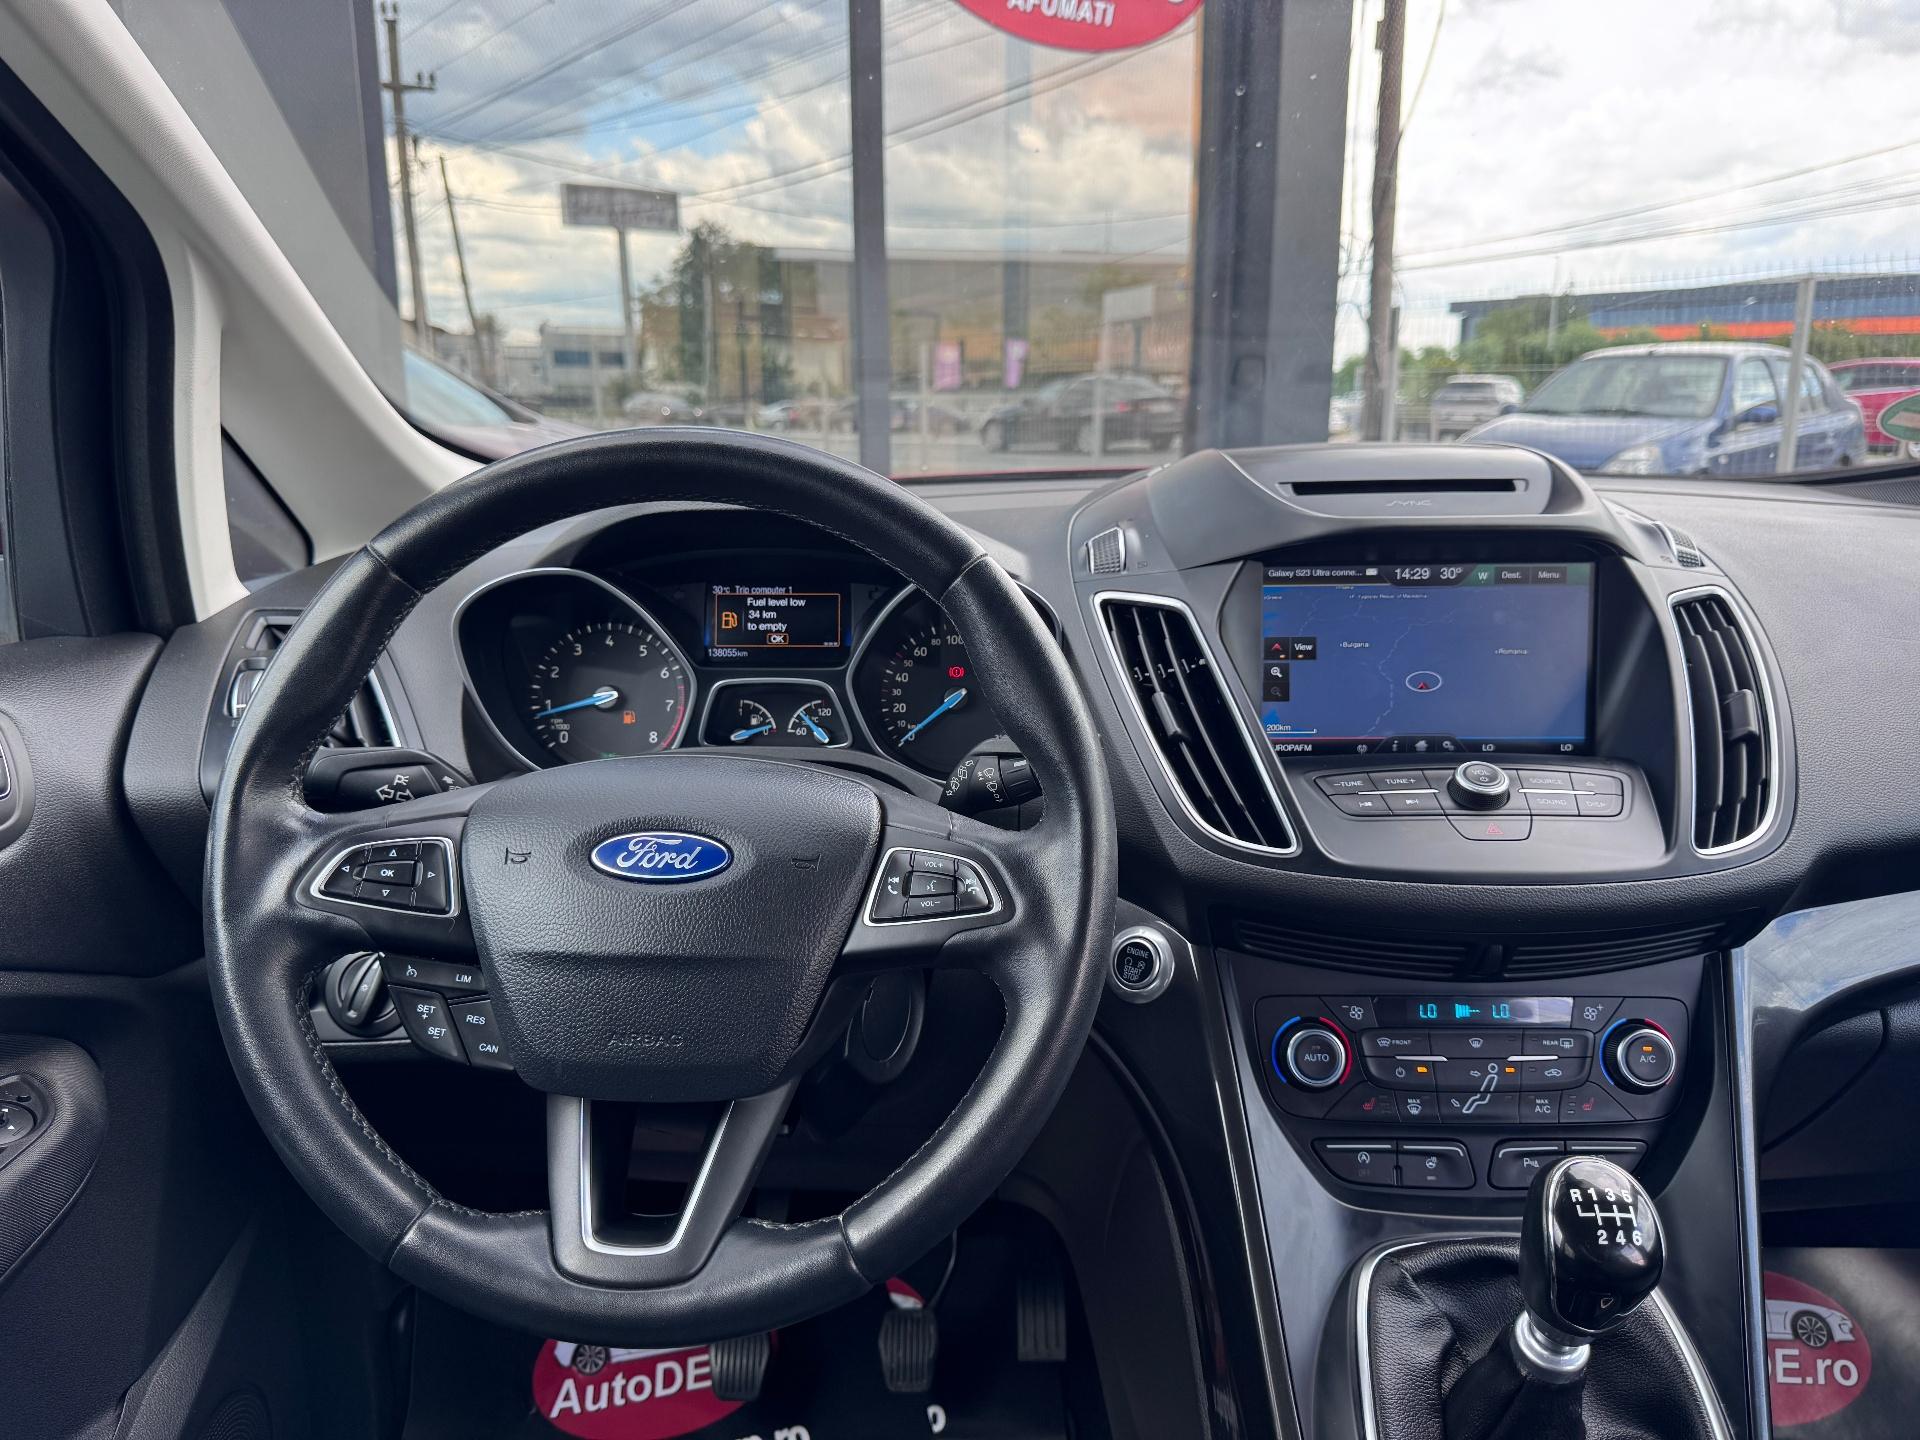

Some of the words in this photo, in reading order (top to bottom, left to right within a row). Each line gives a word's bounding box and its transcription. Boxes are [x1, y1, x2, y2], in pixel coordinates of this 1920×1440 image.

[1268, 569, 1293, 578] Galaxy
[1296, 569, 1310, 577] S23
[1312, 569, 1330, 577] Ultra
[1395, 568, 1430, 580] 14:29
[1440, 567, 1463, 579] 30°
[1478, 571, 1488, 580] W
[1502, 571, 1522, 579] Dest.
[747, 597, 766, 607] Fuel
[768, 597, 788, 607] level
[790, 597, 806, 607] low
[749, 610, 760, 619] 34
[762, 610, 777, 619] km
[748, 622, 757, 631] to
[758, 623, 788, 633] empty
[605, 635, 614, 647] 4
[771, 635, 784, 643] OK
[930, 638, 941, 646] 80
[573, 643, 582, 655] 3
[639, 645, 647, 656] 5
[913, 647, 927, 656] 60
[1294, 643, 1313, 651] View
[903, 659, 913, 667] 50
[551, 667, 559, 678] 2
[660, 667, 669, 678] 6
[895, 673, 909, 682] 40
[891, 688, 901, 696] 30
[665, 700, 674, 711] 7
[892, 703, 906, 712] 20
[817, 708, 831, 716] 120
[795, 728, 807, 736] 60
[1267, 723, 1291, 731] 200km
[559, 730, 569, 743] 0
[649, 731, 658, 743] 8
[616, 836, 702, 870] Ford
[380, 868, 394, 878] OK
[1126, 946, 1149, 959] ENGINE
[1123, 965, 1142, 976] START
[456, 973, 472, 984] LIM
[416, 1003, 436, 1014] SET
[466, 1014, 486, 1025] RES
[428, 1026, 447, 1038] SET
[479, 1043, 499, 1054] CAN
[1304, 1053, 1330, 1063] AUTO
[1639, 1055, 1657, 1064] A/C
[1534, 1105, 1551, 1114] A/C
[1570, 1188, 1583, 1202] R
[1588, 1187, 1598, 1201] 1
[1604, 1187, 1616, 1202] 3
[1621, 1189, 1632, 1203] 5
[1596, 1229, 1608, 1245] 2
[1615, 1229, 1626, 1246] 4
[1632, 1230, 1642, 1246] 6
[1767, 1347, 1859, 1387] E.ro
[549, 1352, 713, 1419] AutoDE
